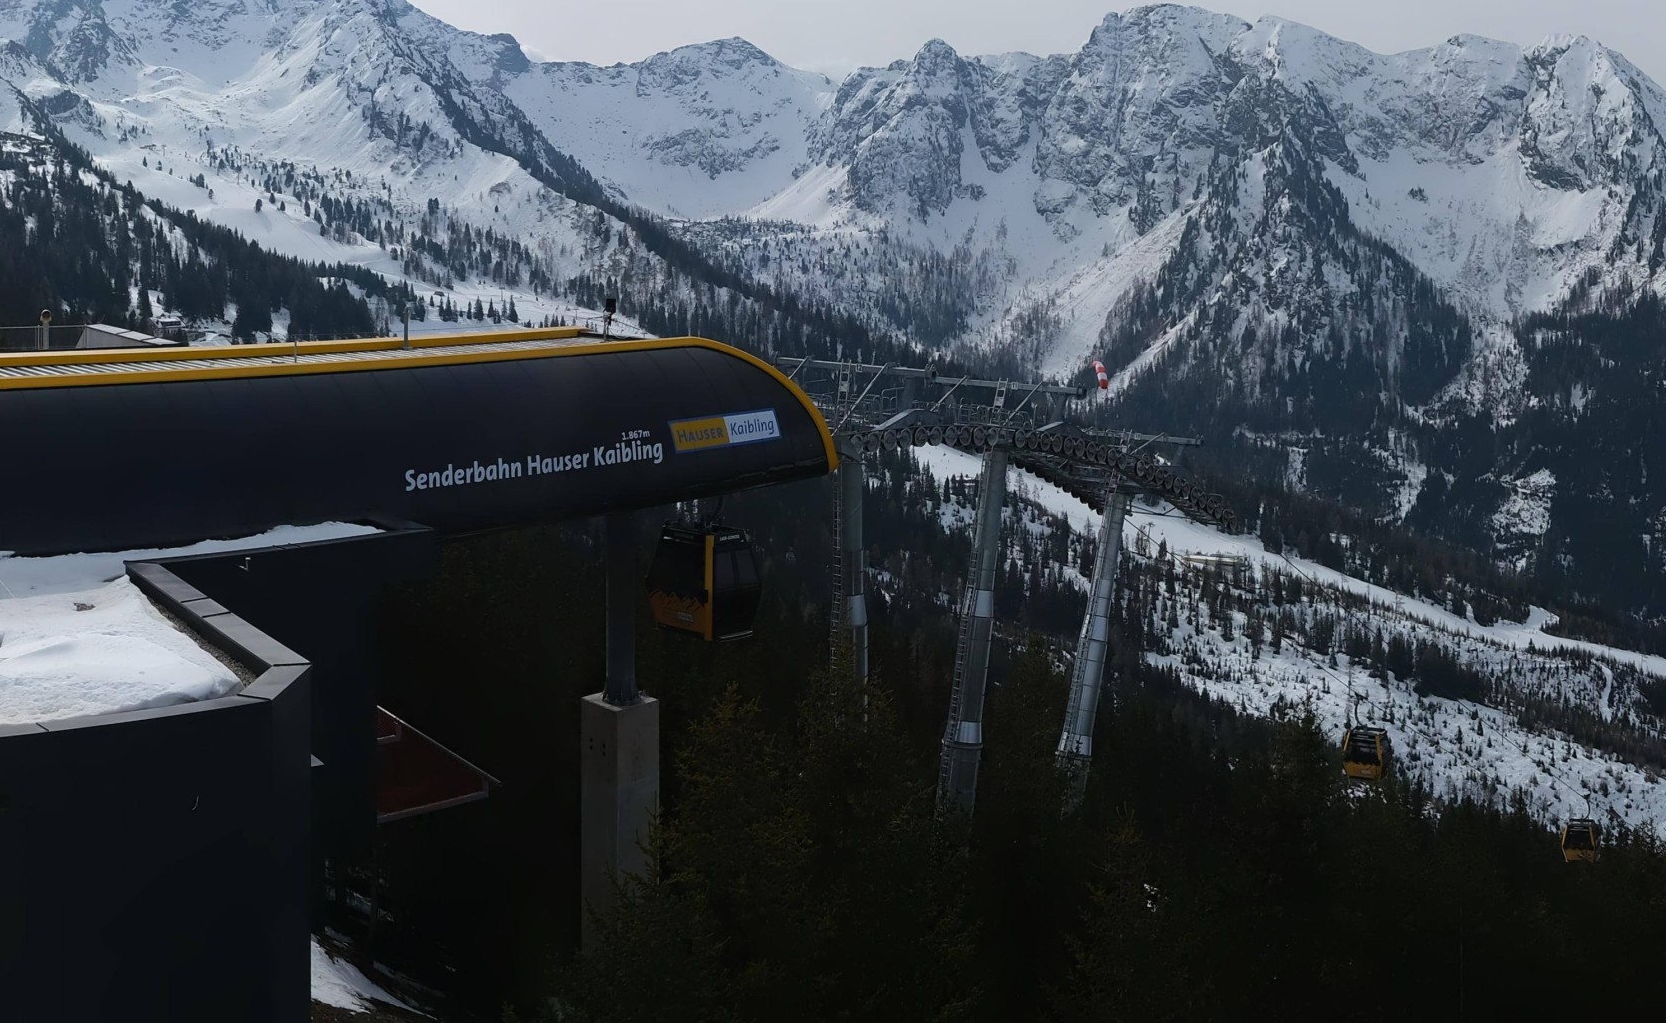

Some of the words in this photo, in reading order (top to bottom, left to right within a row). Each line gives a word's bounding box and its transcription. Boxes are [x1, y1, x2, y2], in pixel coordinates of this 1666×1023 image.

[621, 428, 650, 440] 1.867m
[676, 426, 724, 444] HAUSER
[730, 417, 775, 436] Kaibling
[404, 457, 522, 492] Senderbahn
[527, 449, 590, 476] Hauser
[593, 440, 663, 466] Kaibling
